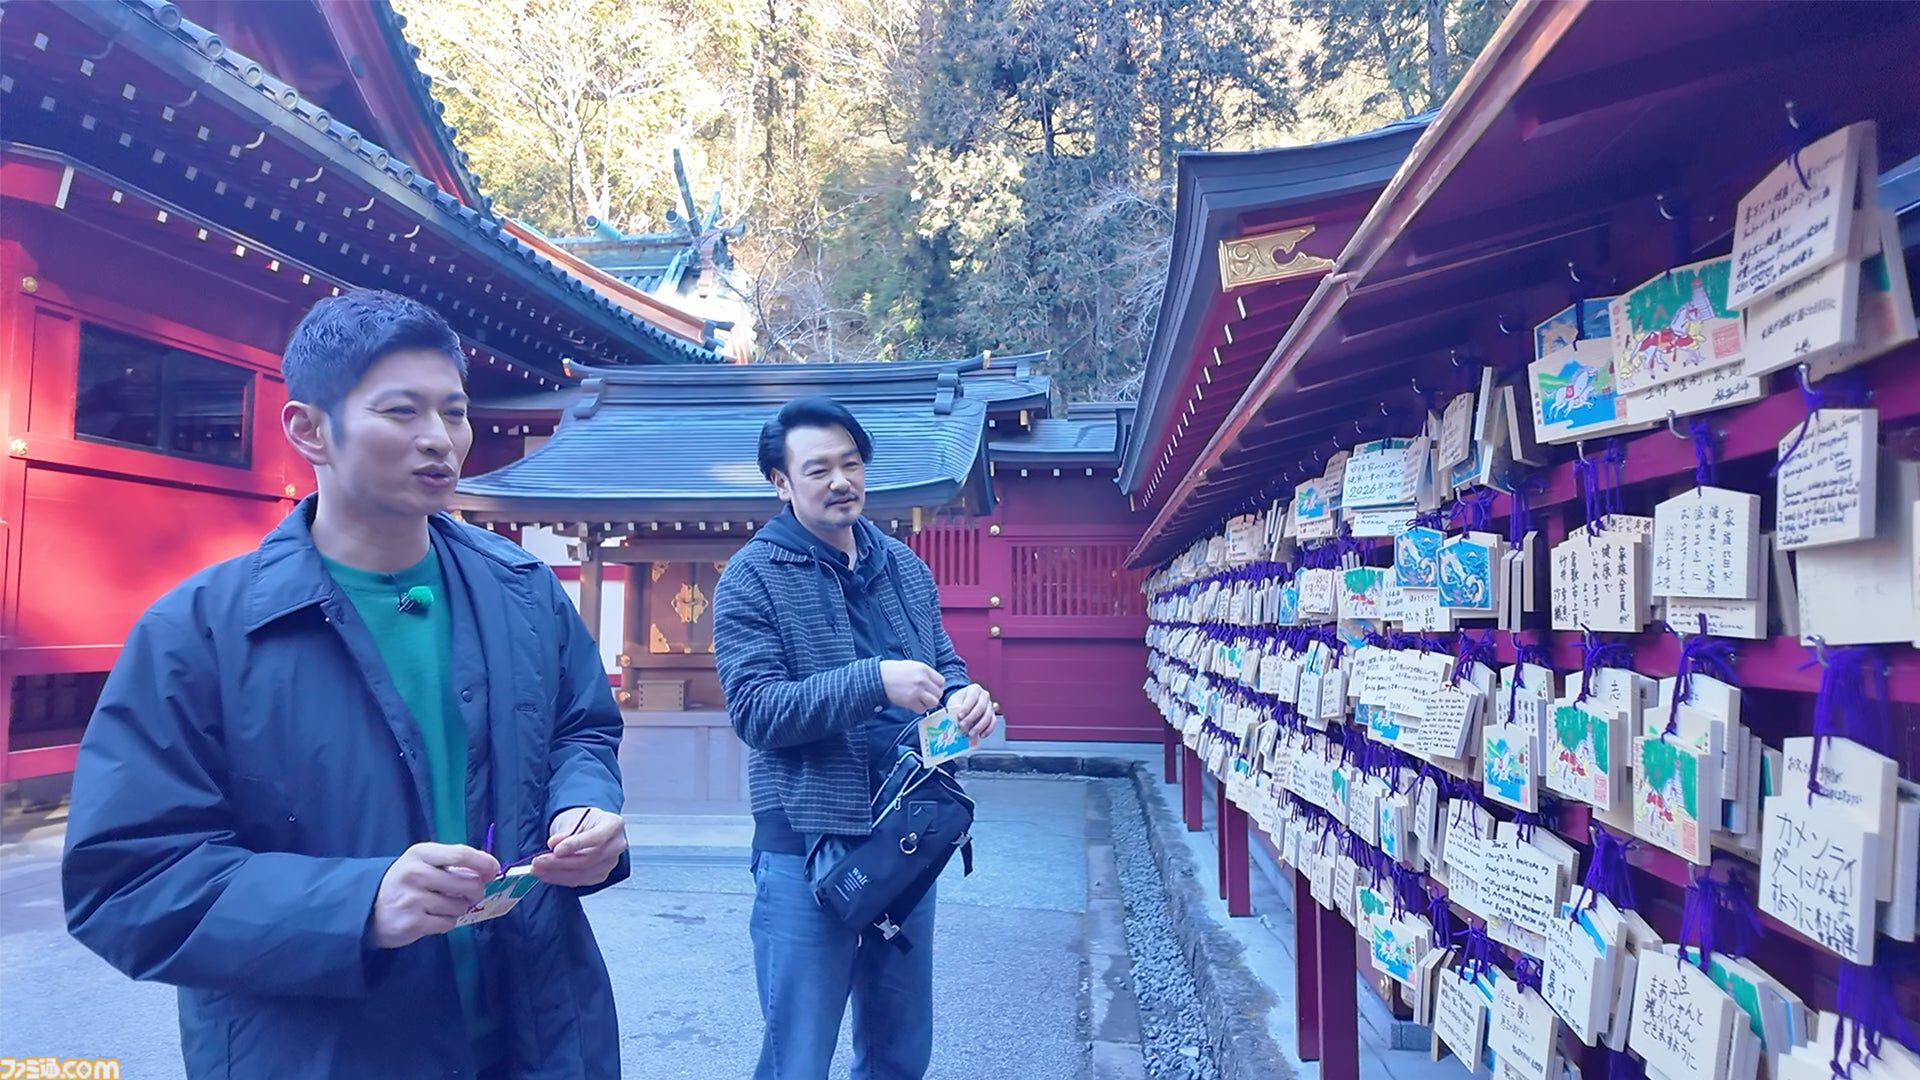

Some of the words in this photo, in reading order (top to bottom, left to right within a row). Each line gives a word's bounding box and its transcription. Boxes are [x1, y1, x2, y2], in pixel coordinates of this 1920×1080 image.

[1775, 812, 1858, 898] カメンライ
